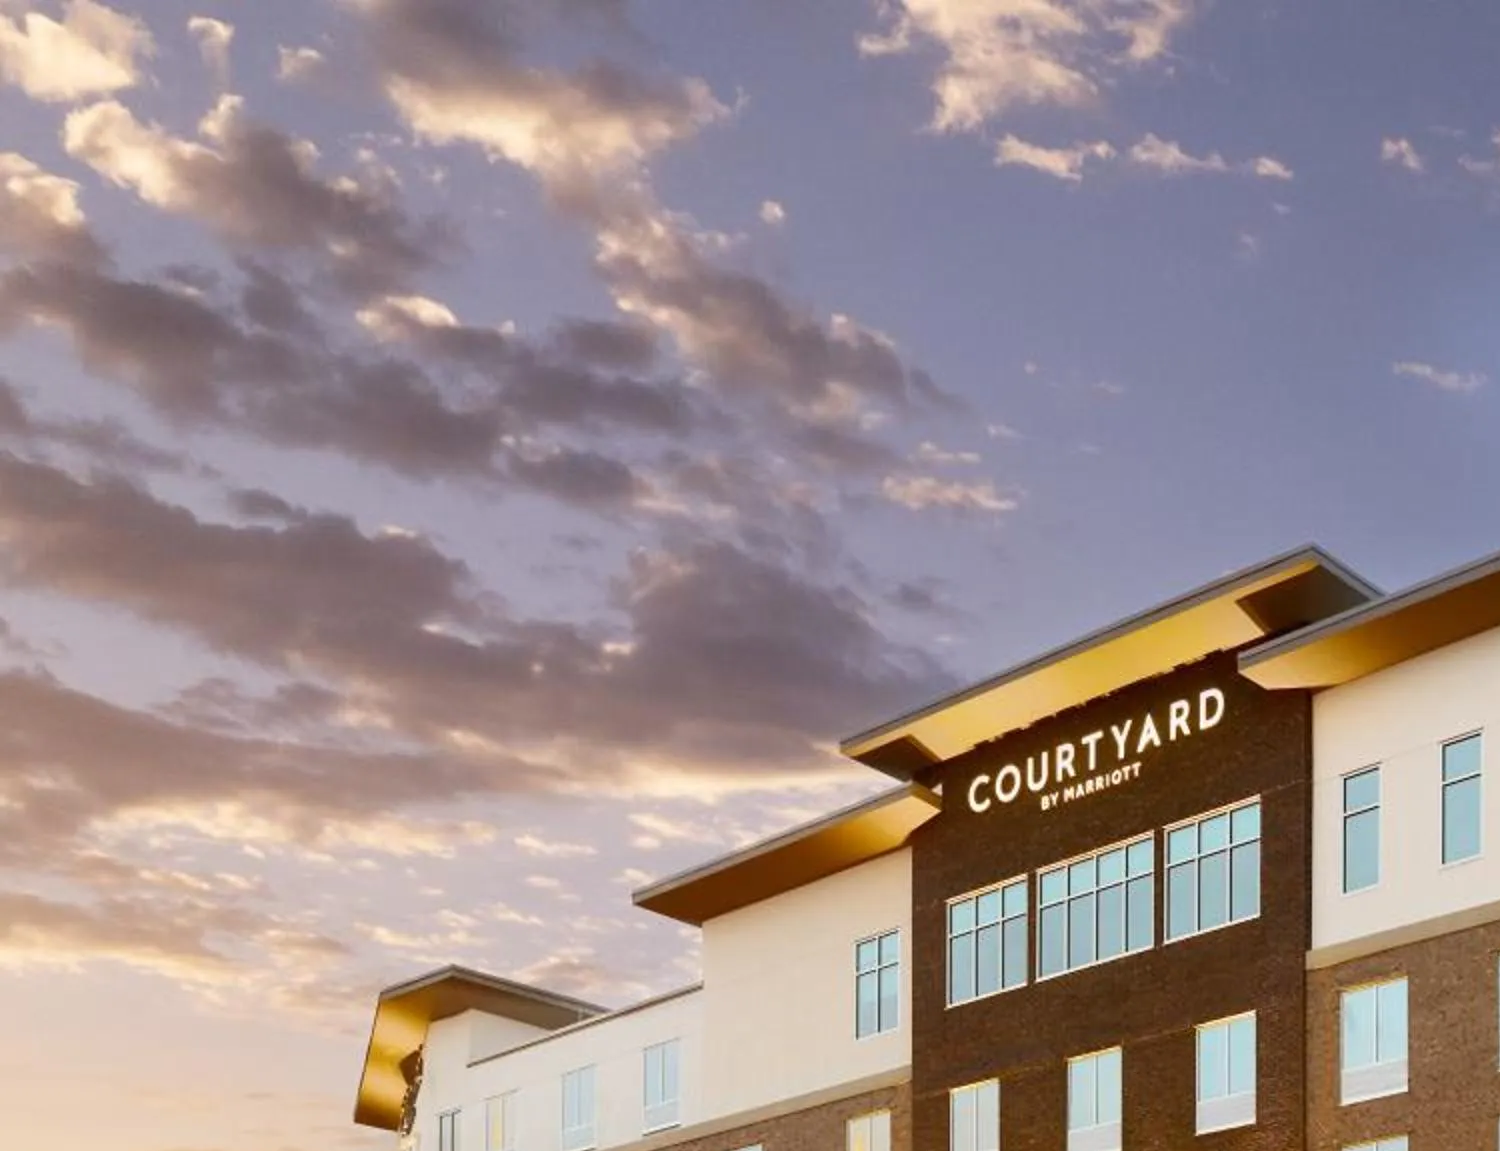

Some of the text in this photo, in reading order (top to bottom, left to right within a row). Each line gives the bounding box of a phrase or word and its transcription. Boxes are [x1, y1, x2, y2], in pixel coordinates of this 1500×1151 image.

[968, 688, 1225, 813] COURTYARD
[1041, 762, 1142, 811] BY MARRIOTT
